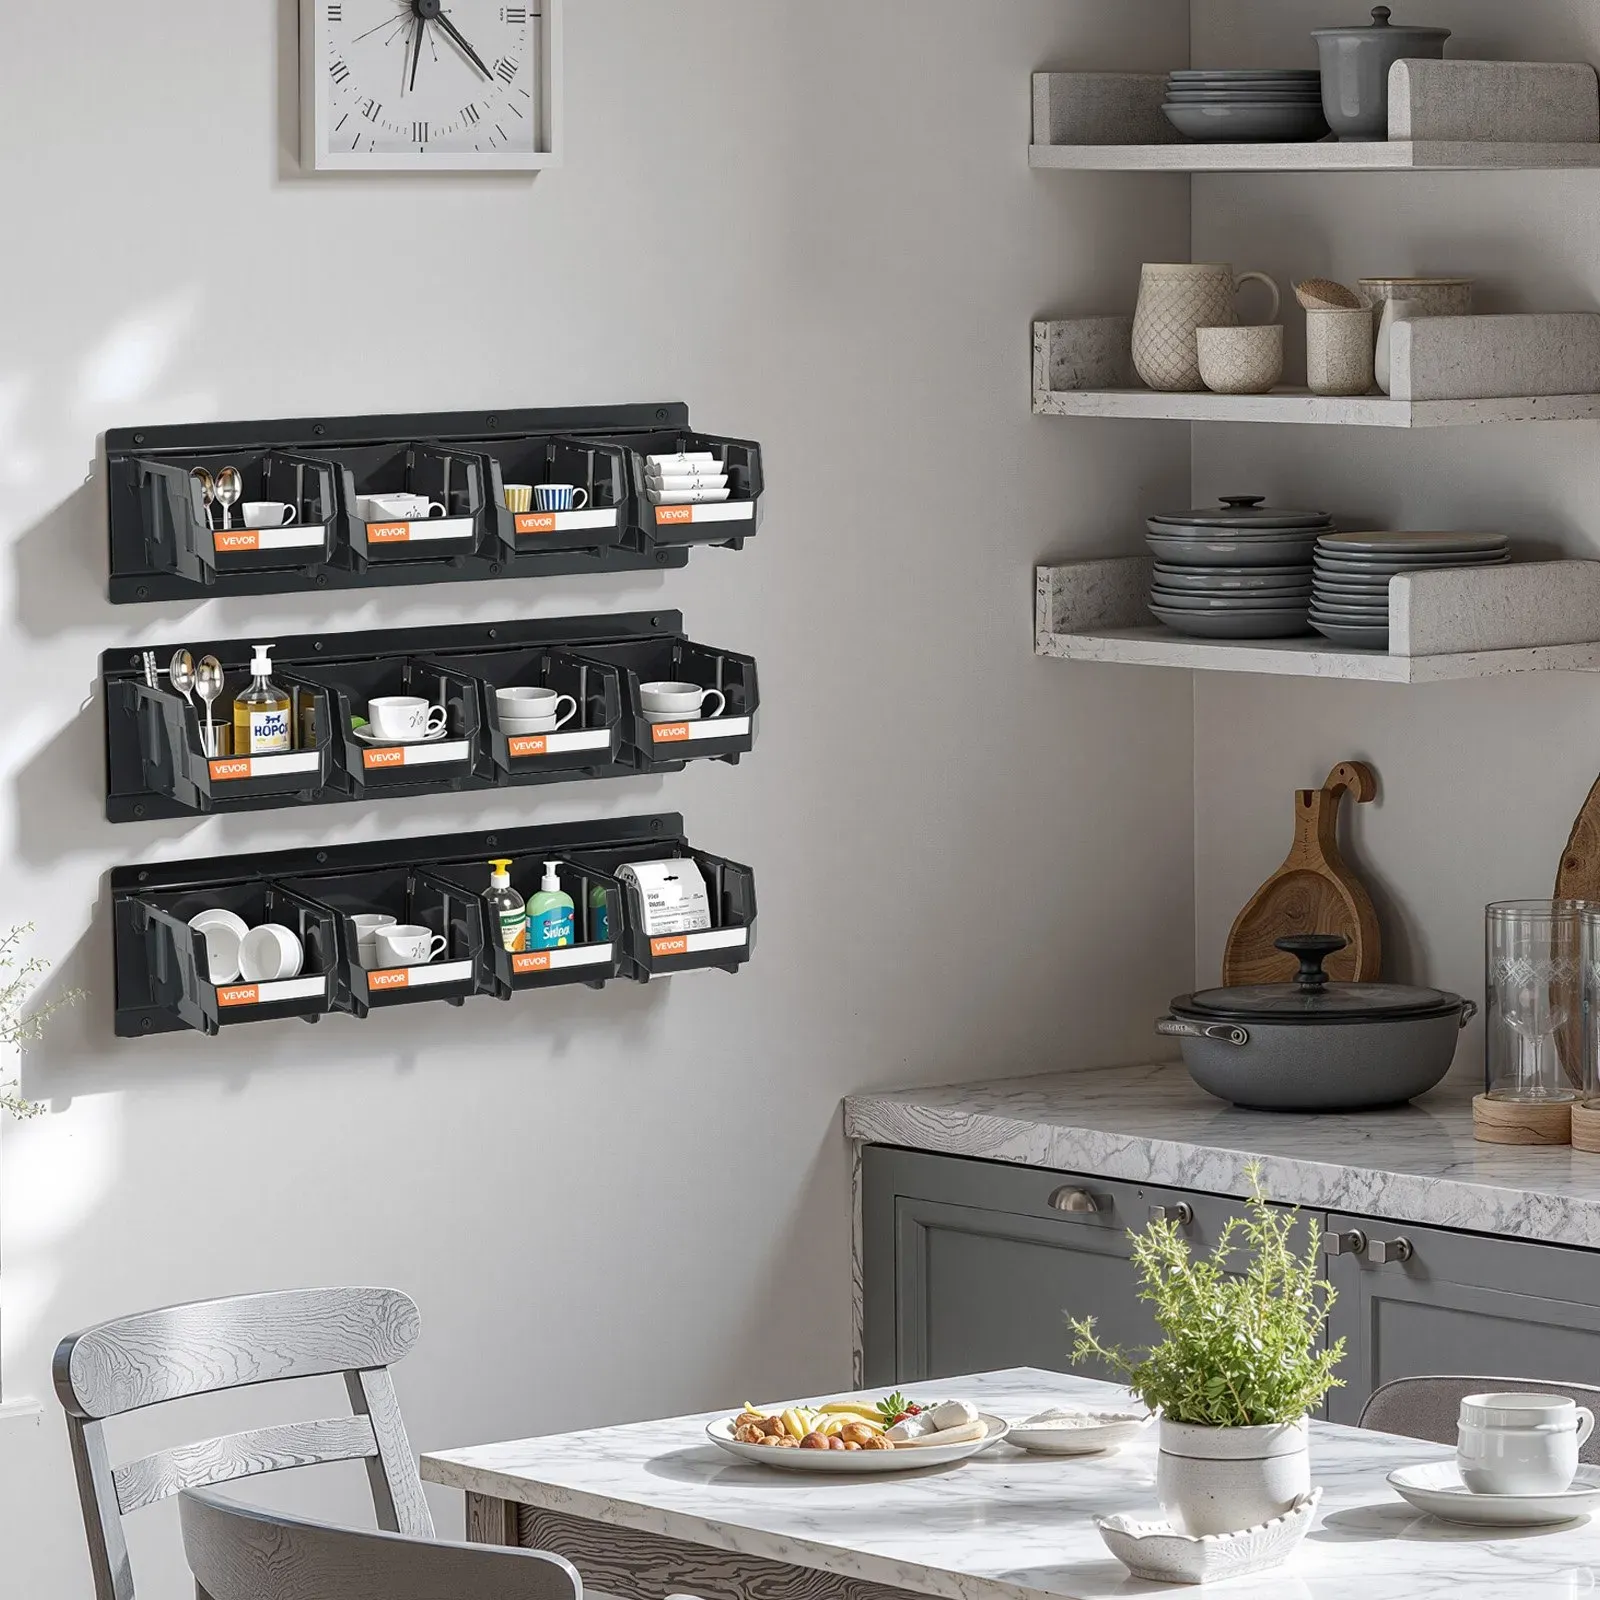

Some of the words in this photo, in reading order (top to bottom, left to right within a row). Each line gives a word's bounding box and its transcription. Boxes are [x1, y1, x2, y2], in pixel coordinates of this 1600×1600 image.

[659, 509, 690, 519] VEVOR
[521, 517, 552, 527] VEVOR
[374, 527, 406, 537] VEVOR
[222, 535, 256, 545] VEVOR
[656, 727, 686, 737] VEVOR
[513, 740, 544, 750] VEVOR
[369, 752, 401, 762] VEVOR
[215, 763, 248, 774] VEVOR
[655, 940, 685, 951] VEVOR
[516, 956, 548, 967] VEVOR
[373, 974, 405, 984] VEVOR
[223, 989, 256, 1000] VEVOR
